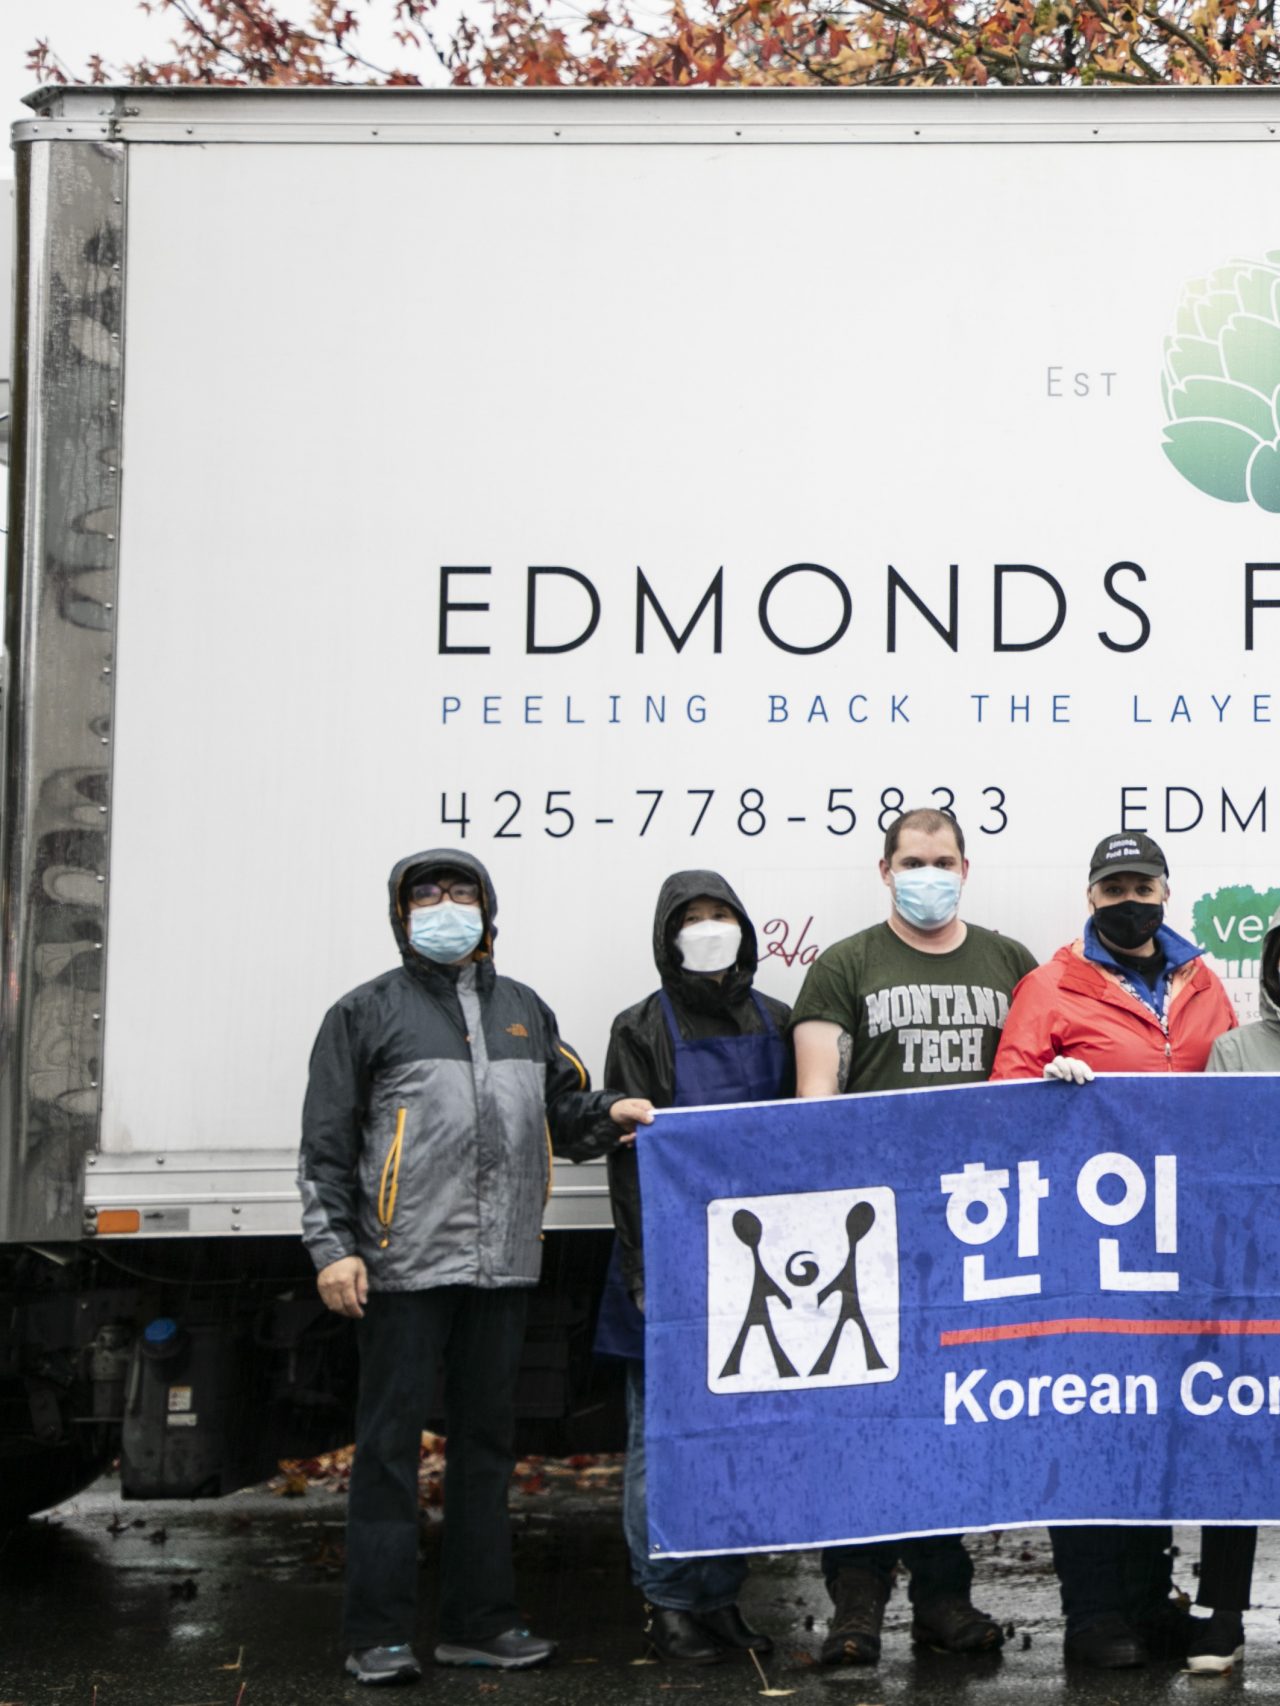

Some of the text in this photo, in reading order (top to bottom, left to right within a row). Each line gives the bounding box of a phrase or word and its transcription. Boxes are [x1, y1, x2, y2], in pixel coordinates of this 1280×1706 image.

[438, 561, 1152, 657] EDMONDS
[443, 695, 708, 726] PEELING
[768, 695, 911, 725] BACK
[971, 695, 1072, 724] THE
[440, 787, 1009, 839] 425-778-5833
[898, 1028, 984, 1073] TECH
[941, 1152, 1181, 1303] 한인
[944, 1369, 1159, 1426] Korean
